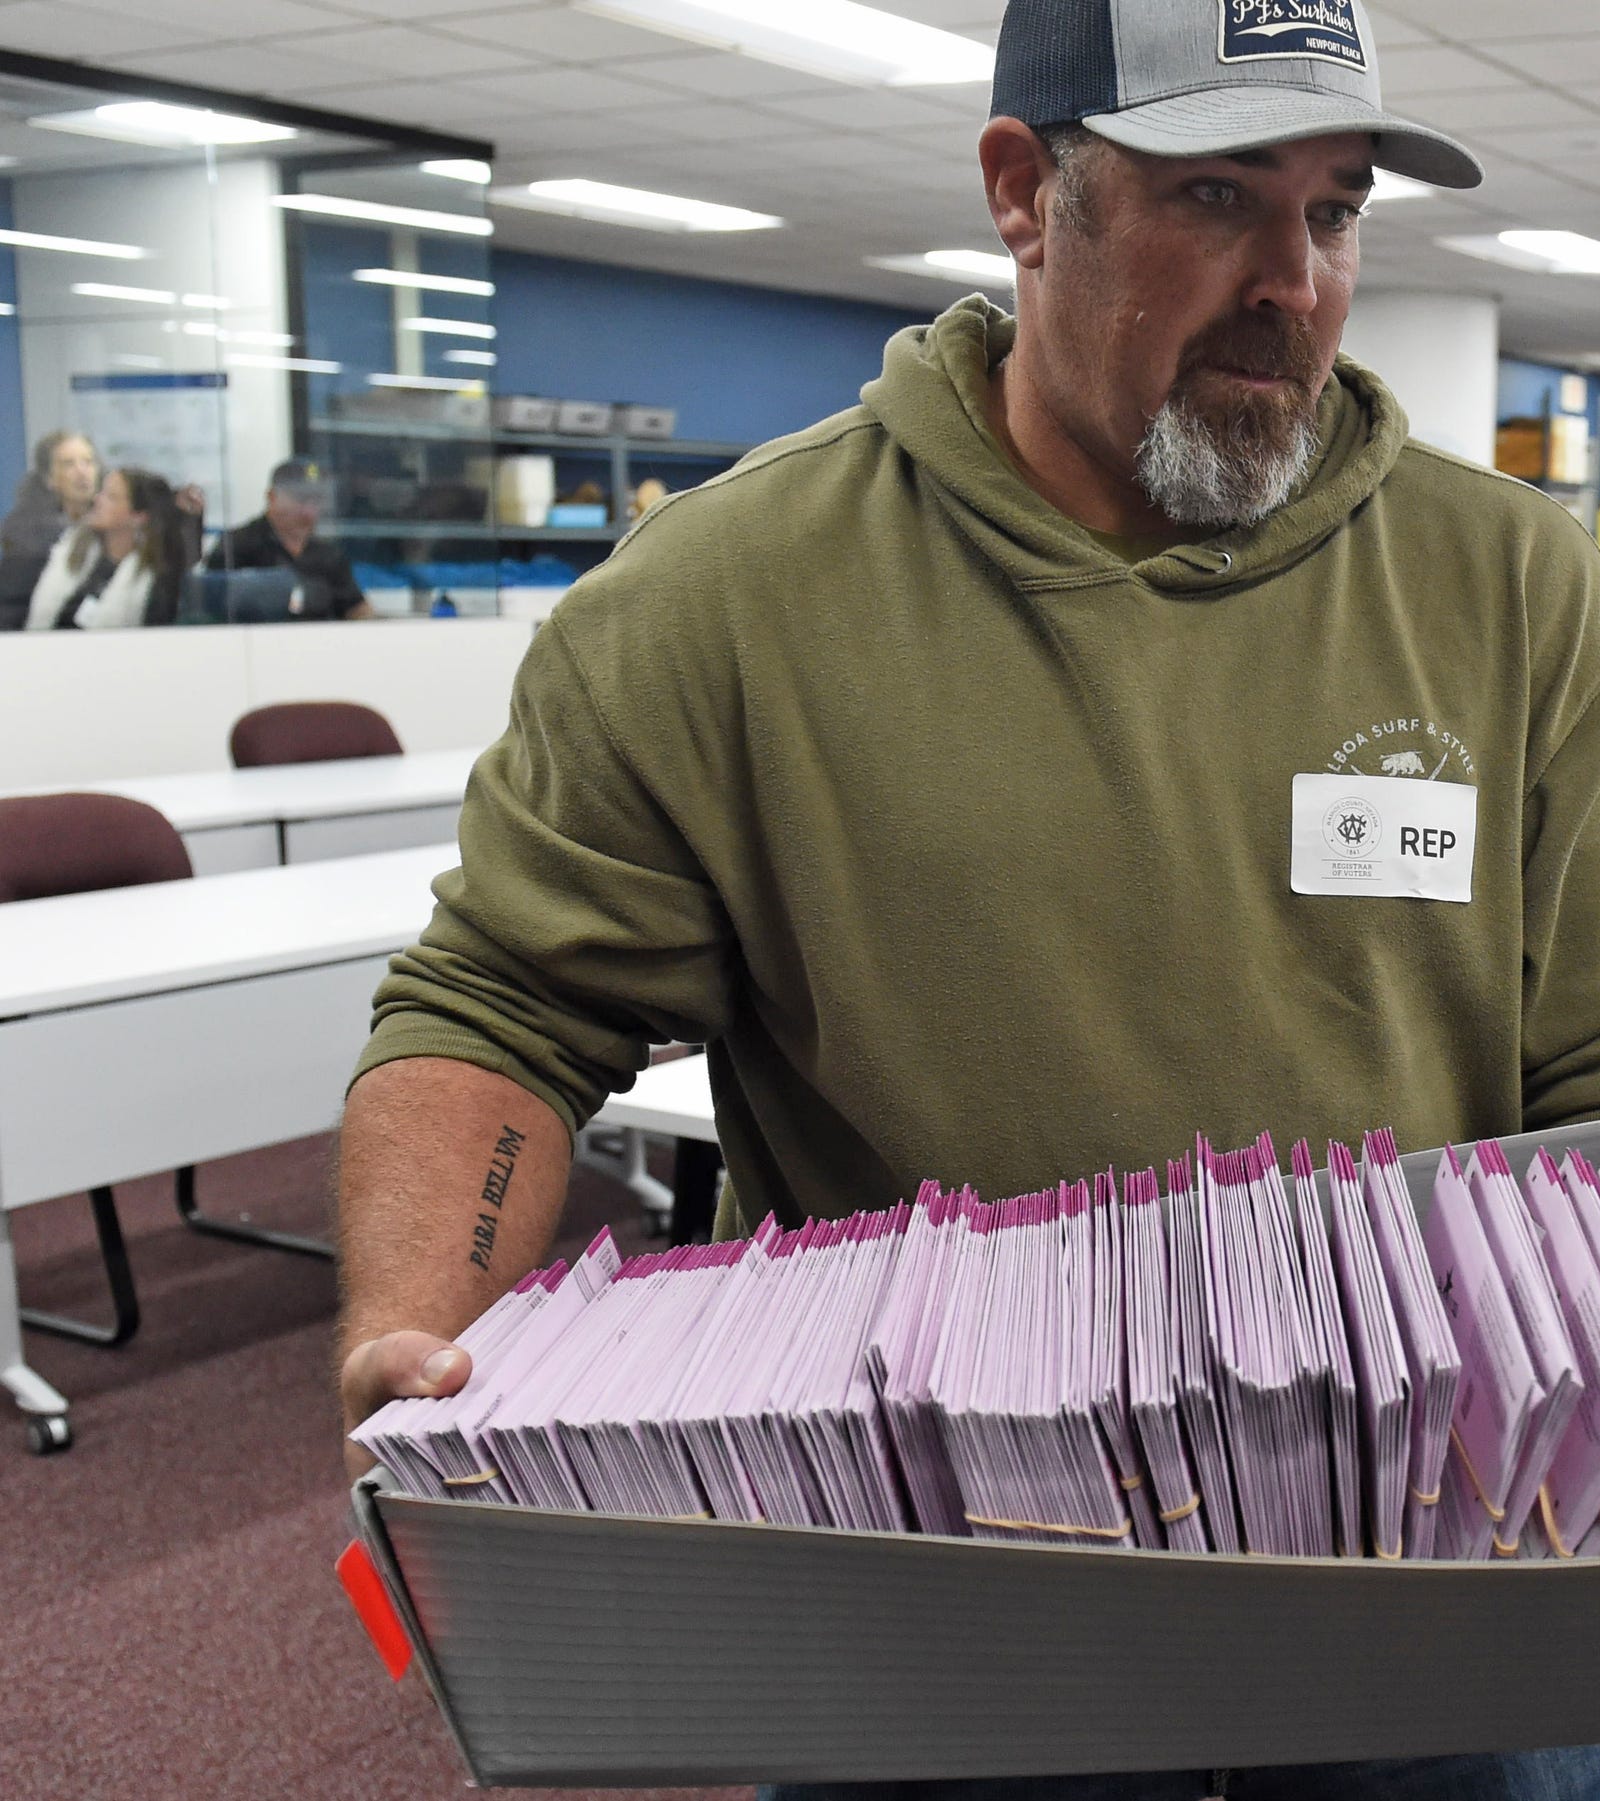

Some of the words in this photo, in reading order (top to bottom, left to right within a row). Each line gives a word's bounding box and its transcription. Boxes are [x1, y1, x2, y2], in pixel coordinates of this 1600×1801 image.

[1288, 0, 1353, 32] Surfrider
[1305, 36, 1340, 53] NEWPORT
[1341, 45, 1361, 60] BEACH
[1326, 731, 1369, 774] LBOA
[1371, 718, 1420, 738] SURF
[1426, 722, 1437, 737] &
[1441, 731, 1476, 776] STYLE
[1400, 826, 1456, 858] REP
[1332, 862, 1373, 870] REGISTRAR
[1343, 869, 1372, 877] VOTERS
